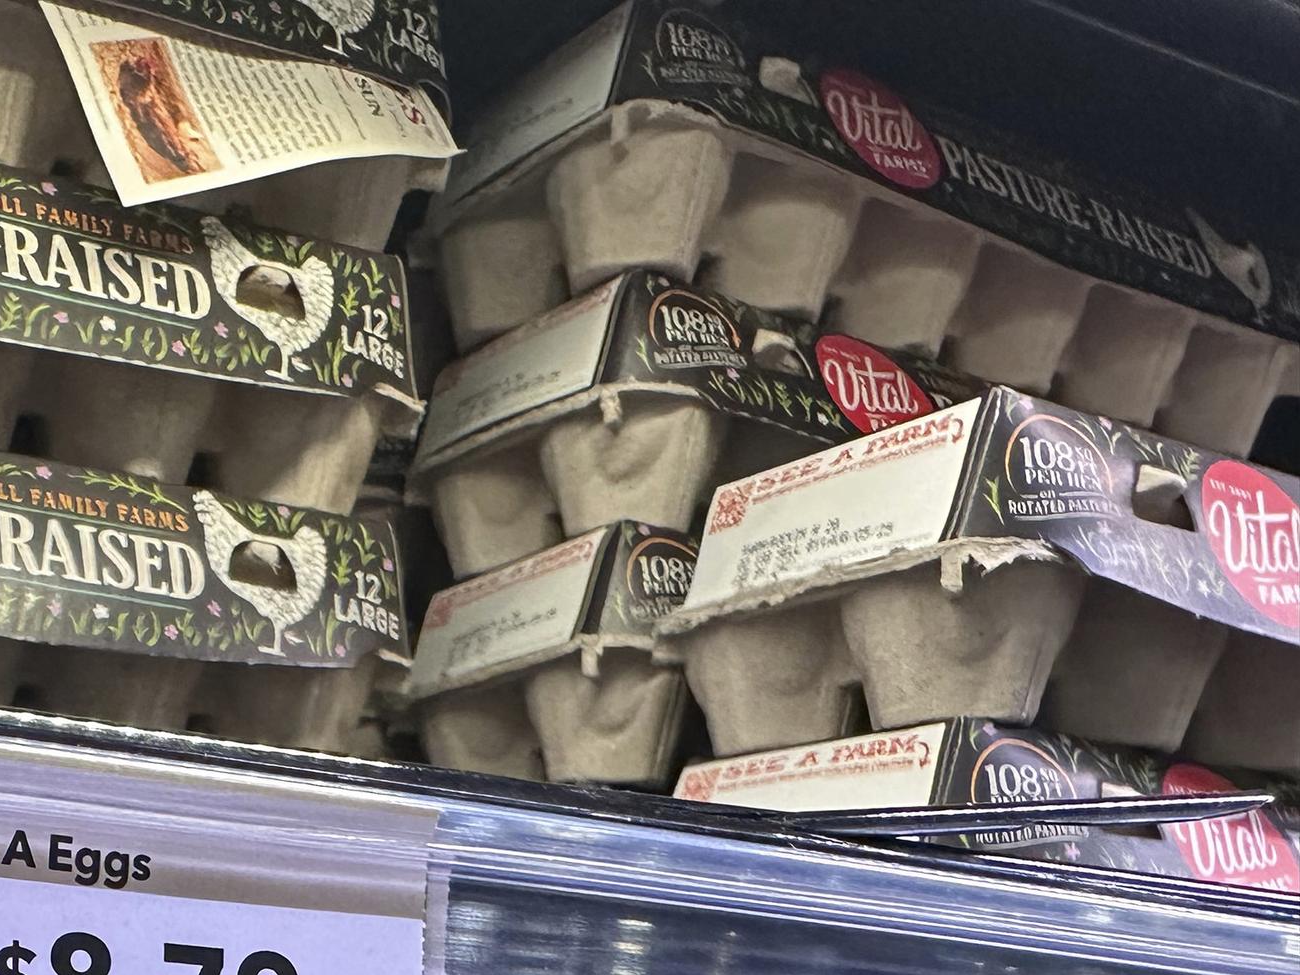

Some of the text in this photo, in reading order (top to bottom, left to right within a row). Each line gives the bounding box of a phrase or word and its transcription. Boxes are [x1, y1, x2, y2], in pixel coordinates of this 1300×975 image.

[402, 8, 429, 41] 12
[826, 90, 923, 151] Vital
[35, 203, 114, 237] FAMILY
[934, 134, 1213, 279] PASTURE-RAISED
[361, 304, 389, 341] 12
[660, 305, 705, 334] 108
[340, 324, 405, 380] LARGE
[824, 356, 919, 415] Vital
[1020, 436, 1076, 472] 108
[1025, 468, 1063, 486] PER
[29, 488, 110, 518] FAMILY
[117, 503, 191, 532] FARMS
[1008, 499, 1066, 515] ROTATED
[1209, 490, 1300, 574] Vital
[637, 555, 686, 582] 108
[354, 570, 382, 605] 12
[1257, 584, 1300, 606] FAR
[333, 593, 400, 641] LARGE
[984, 763, 1041, 798] 108
[1, 830, 37, 869] A
[49, 834, 152, 890] Eggs
